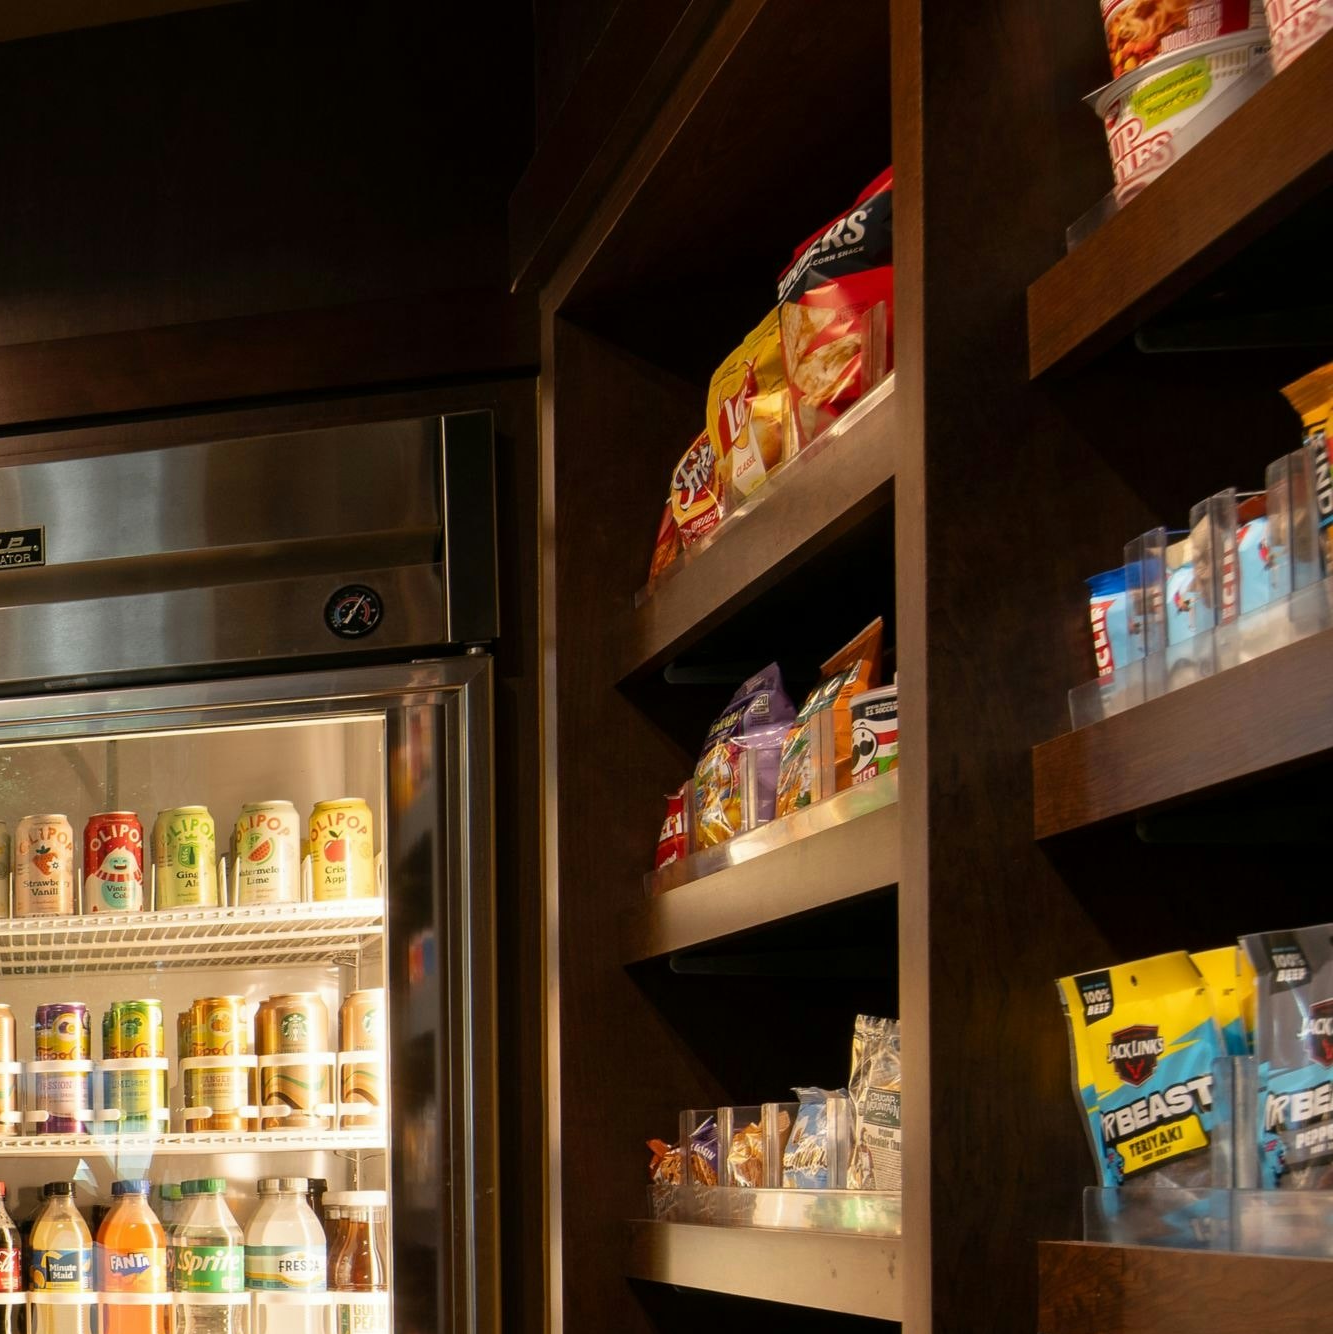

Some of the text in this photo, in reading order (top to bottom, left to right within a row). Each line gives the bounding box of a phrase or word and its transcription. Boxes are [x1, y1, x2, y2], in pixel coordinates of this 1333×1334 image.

[310, 812, 367, 843] OLIPOP
[324, 865, 346, 875] Cris
[246, 876, 270, 885] Lime
[324, 875, 348, 885] Appl
[31, 887, 61, 896] Vanill
[1271, 952, 1308, 968] 100%
[1276, 966, 1308, 983] BEEF
[1083, 989, 1111, 1005] 100%
[1087, 1001, 1111, 1016] BEEF
[1128, 1125, 1183, 1158] TERIYAKI
[1295, 1124, 1333, 1150] PEPPE
[49, 1263, 77, 1272] Minute
[109, 1251, 151, 1273] FANTA
[178, 1251, 240, 1275] Sprite
[52, 1271, 73, 1279] Maid
